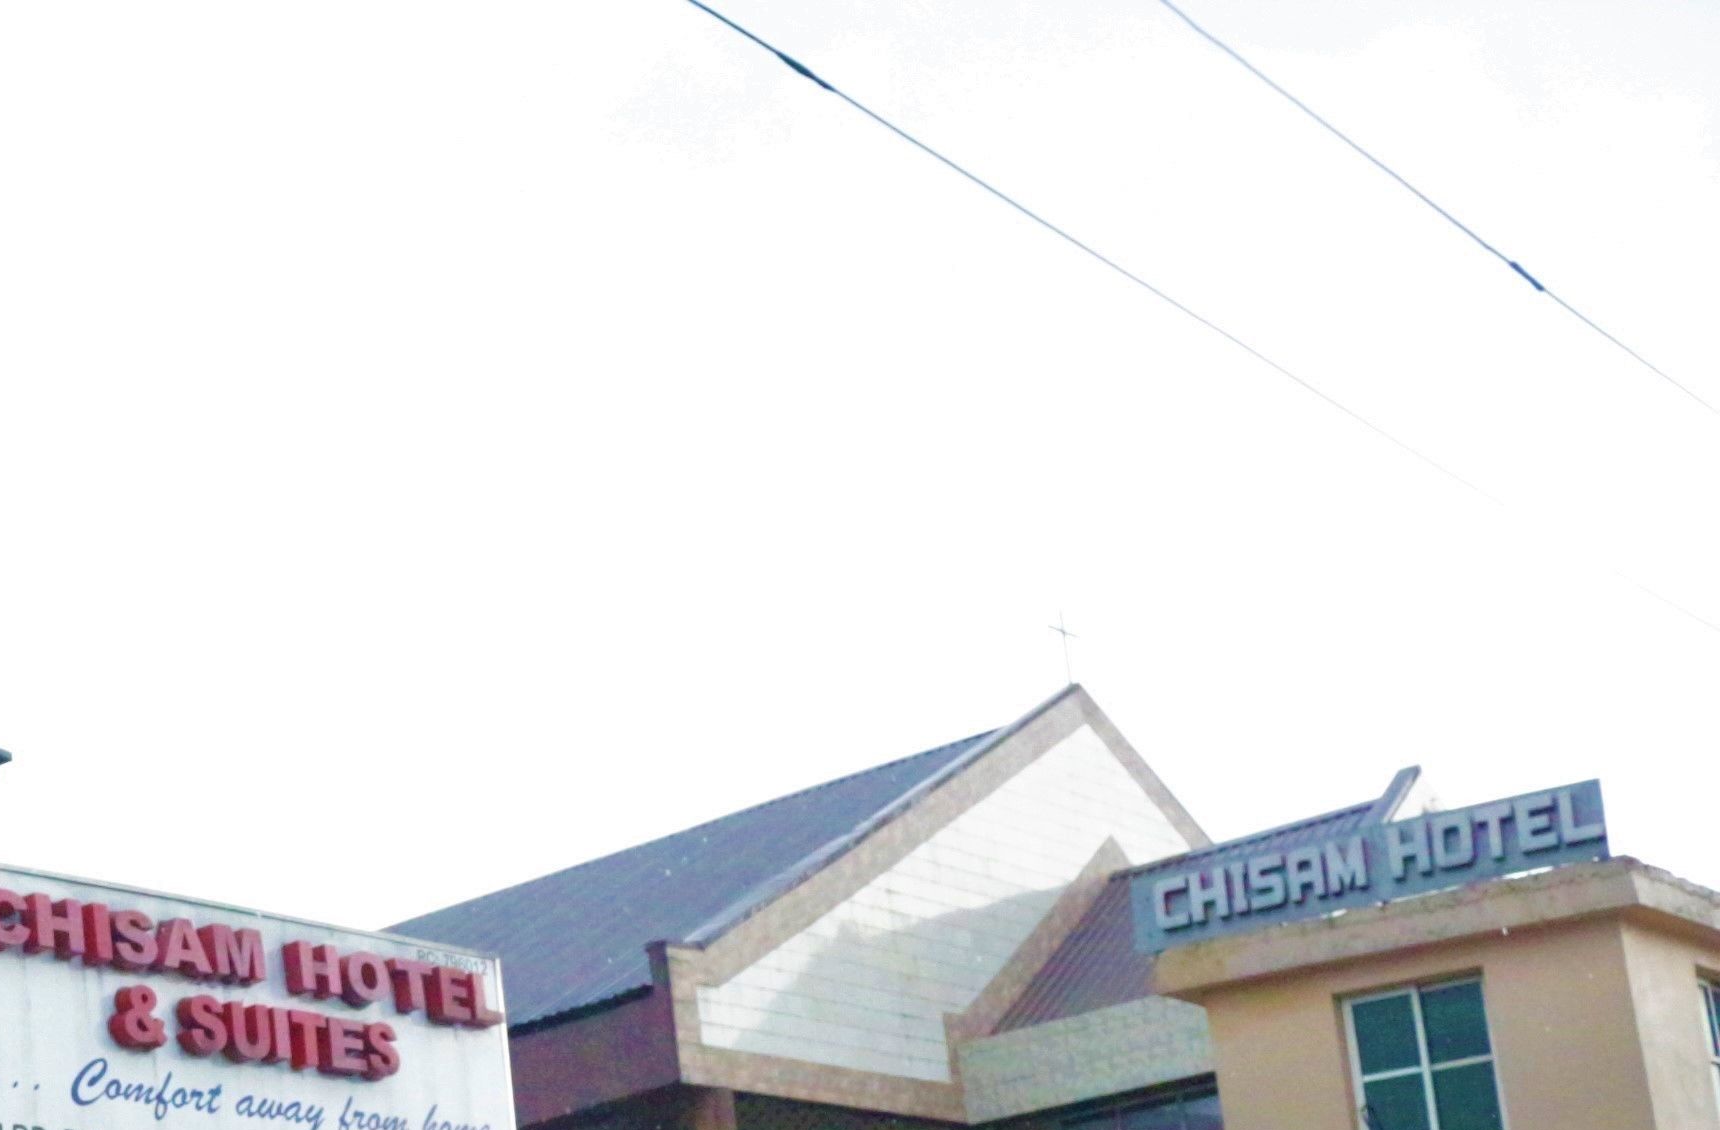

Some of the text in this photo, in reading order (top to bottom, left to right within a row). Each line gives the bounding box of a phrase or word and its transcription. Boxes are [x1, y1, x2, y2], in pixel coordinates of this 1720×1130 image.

[1154, 790, 1606, 933] CHISAM HOTEL
[283, 940, 504, 1029] HOTEL
[109, 985, 400, 1082] & SUITES
[71, 1058, 222, 1121] Comfort
